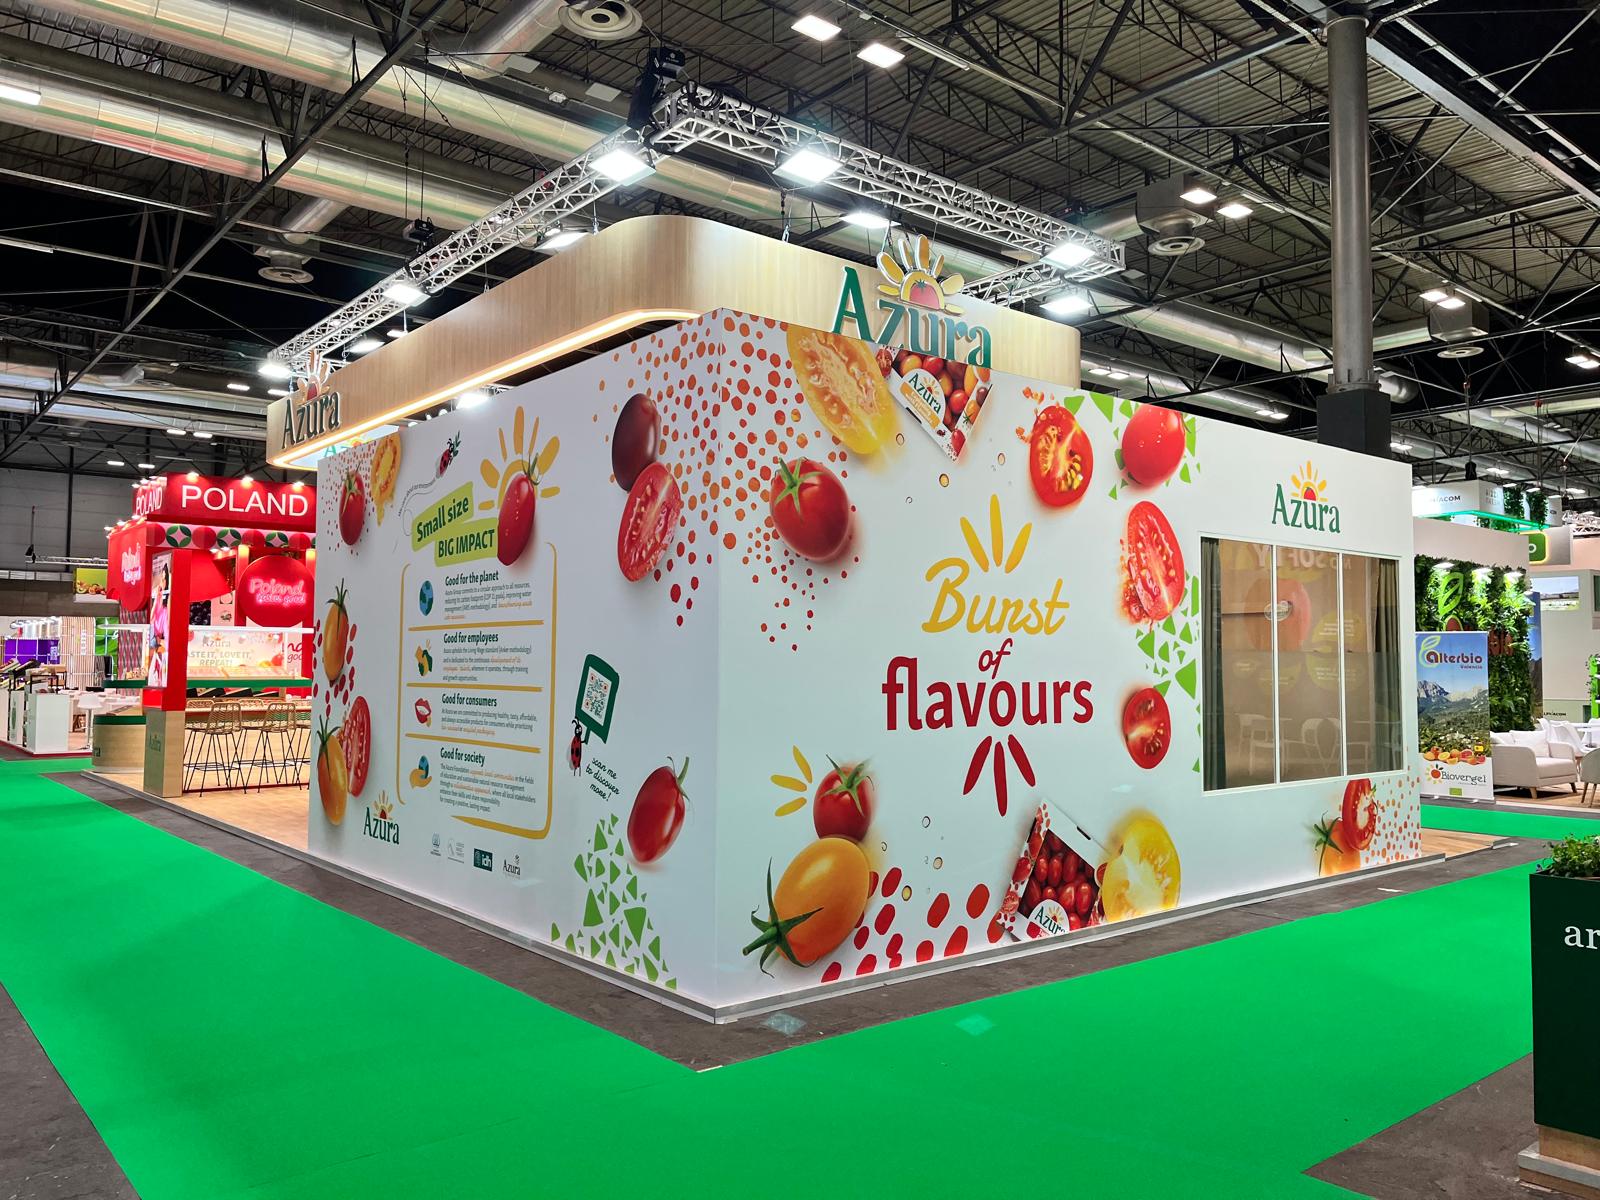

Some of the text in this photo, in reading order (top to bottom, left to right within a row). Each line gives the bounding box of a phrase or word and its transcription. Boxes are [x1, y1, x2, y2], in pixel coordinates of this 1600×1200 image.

[831, 266, 992, 368] Azura
[909, 373, 941, 414] Azura
[282, 391, 341, 450] Azura
[136, 487, 163, 516] POLAND
[182, 484, 308, 517] POLAND
[1272, 484, 1340, 533] Azura
[416, 505, 446, 542] Small
[447, 497, 469, 522] size
[438, 529, 495, 558] BIG IMPACT
[249, 578, 304, 595] Poland
[445, 571, 499, 586] Good for the planet
[921, 557, 1070, 635] Burst
[444, 632, 457, 643] Good
[468, 630, 498, 645] employees
[978, 637, 1013, 680] of
[1425, 650, 1483, 664] alterbio
[442, 693, 497, 707] Good for consumers
[882, 656, 1094, 731] flavours
[440, 747, 485, 767] Good for society
[591, 757, 617, 780] scan me
[585, 763, 620, 795] to discover
[589, 783, 612, 802] more!
[1441, 771, 1487, 785] Biovergel
[363, 807, 400, 845] Azura
[503, 859, 521, 875] Azura
[1034, 906, 1066, 934] Azur
